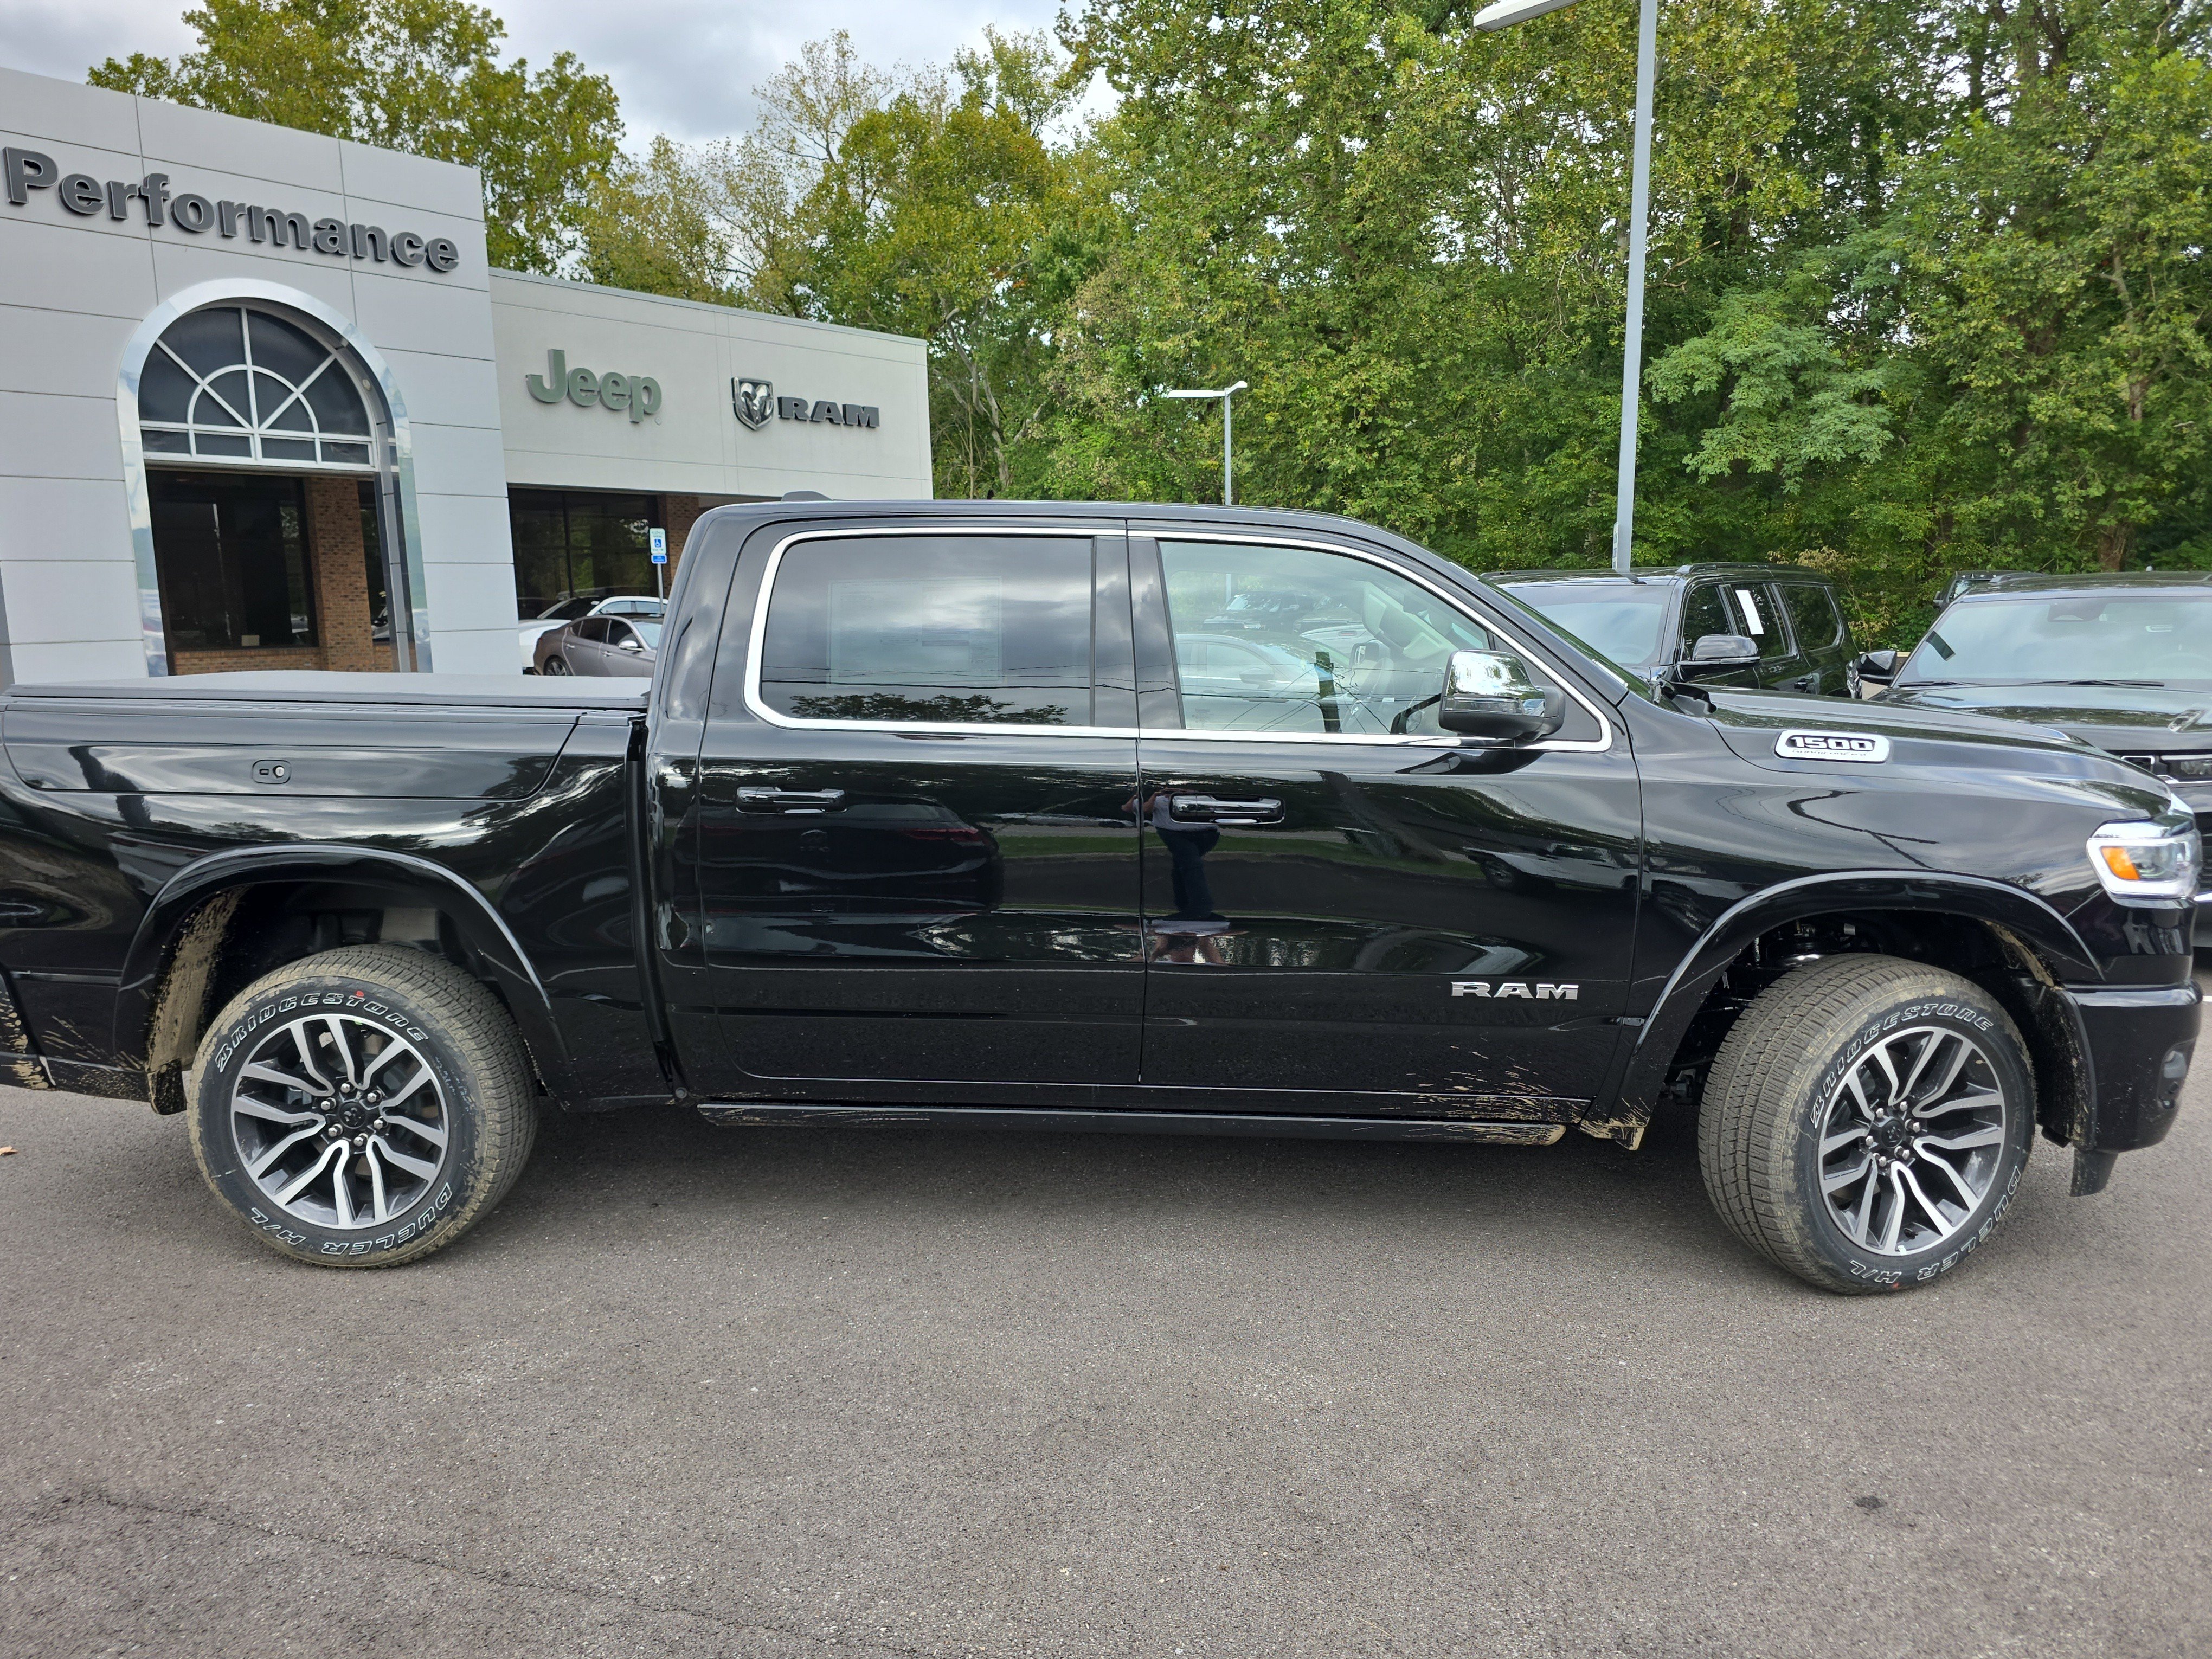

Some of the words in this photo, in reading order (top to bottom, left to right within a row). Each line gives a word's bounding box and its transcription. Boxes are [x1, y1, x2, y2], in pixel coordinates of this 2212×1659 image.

[2, 146, 460, 272] Performance
[526, 349, 662, 423] Jeep
[777, 396, 880, 428] RAM
[1786, 735, 1876, 752] 1500
[1451, 982, 1579, 1000] RAM
[215, 993, 429, 1073] BRIDGESTONE
[1810, 1004, 1993, 1129] BRIDGESTONE
[251, 1207, 307, 1245] H/L
[321, 1182, 452, 1255] DUELER
[1917, 1166, 2021, 1281] DUELER
[1850, 1259, 1901, 1278] H/L
